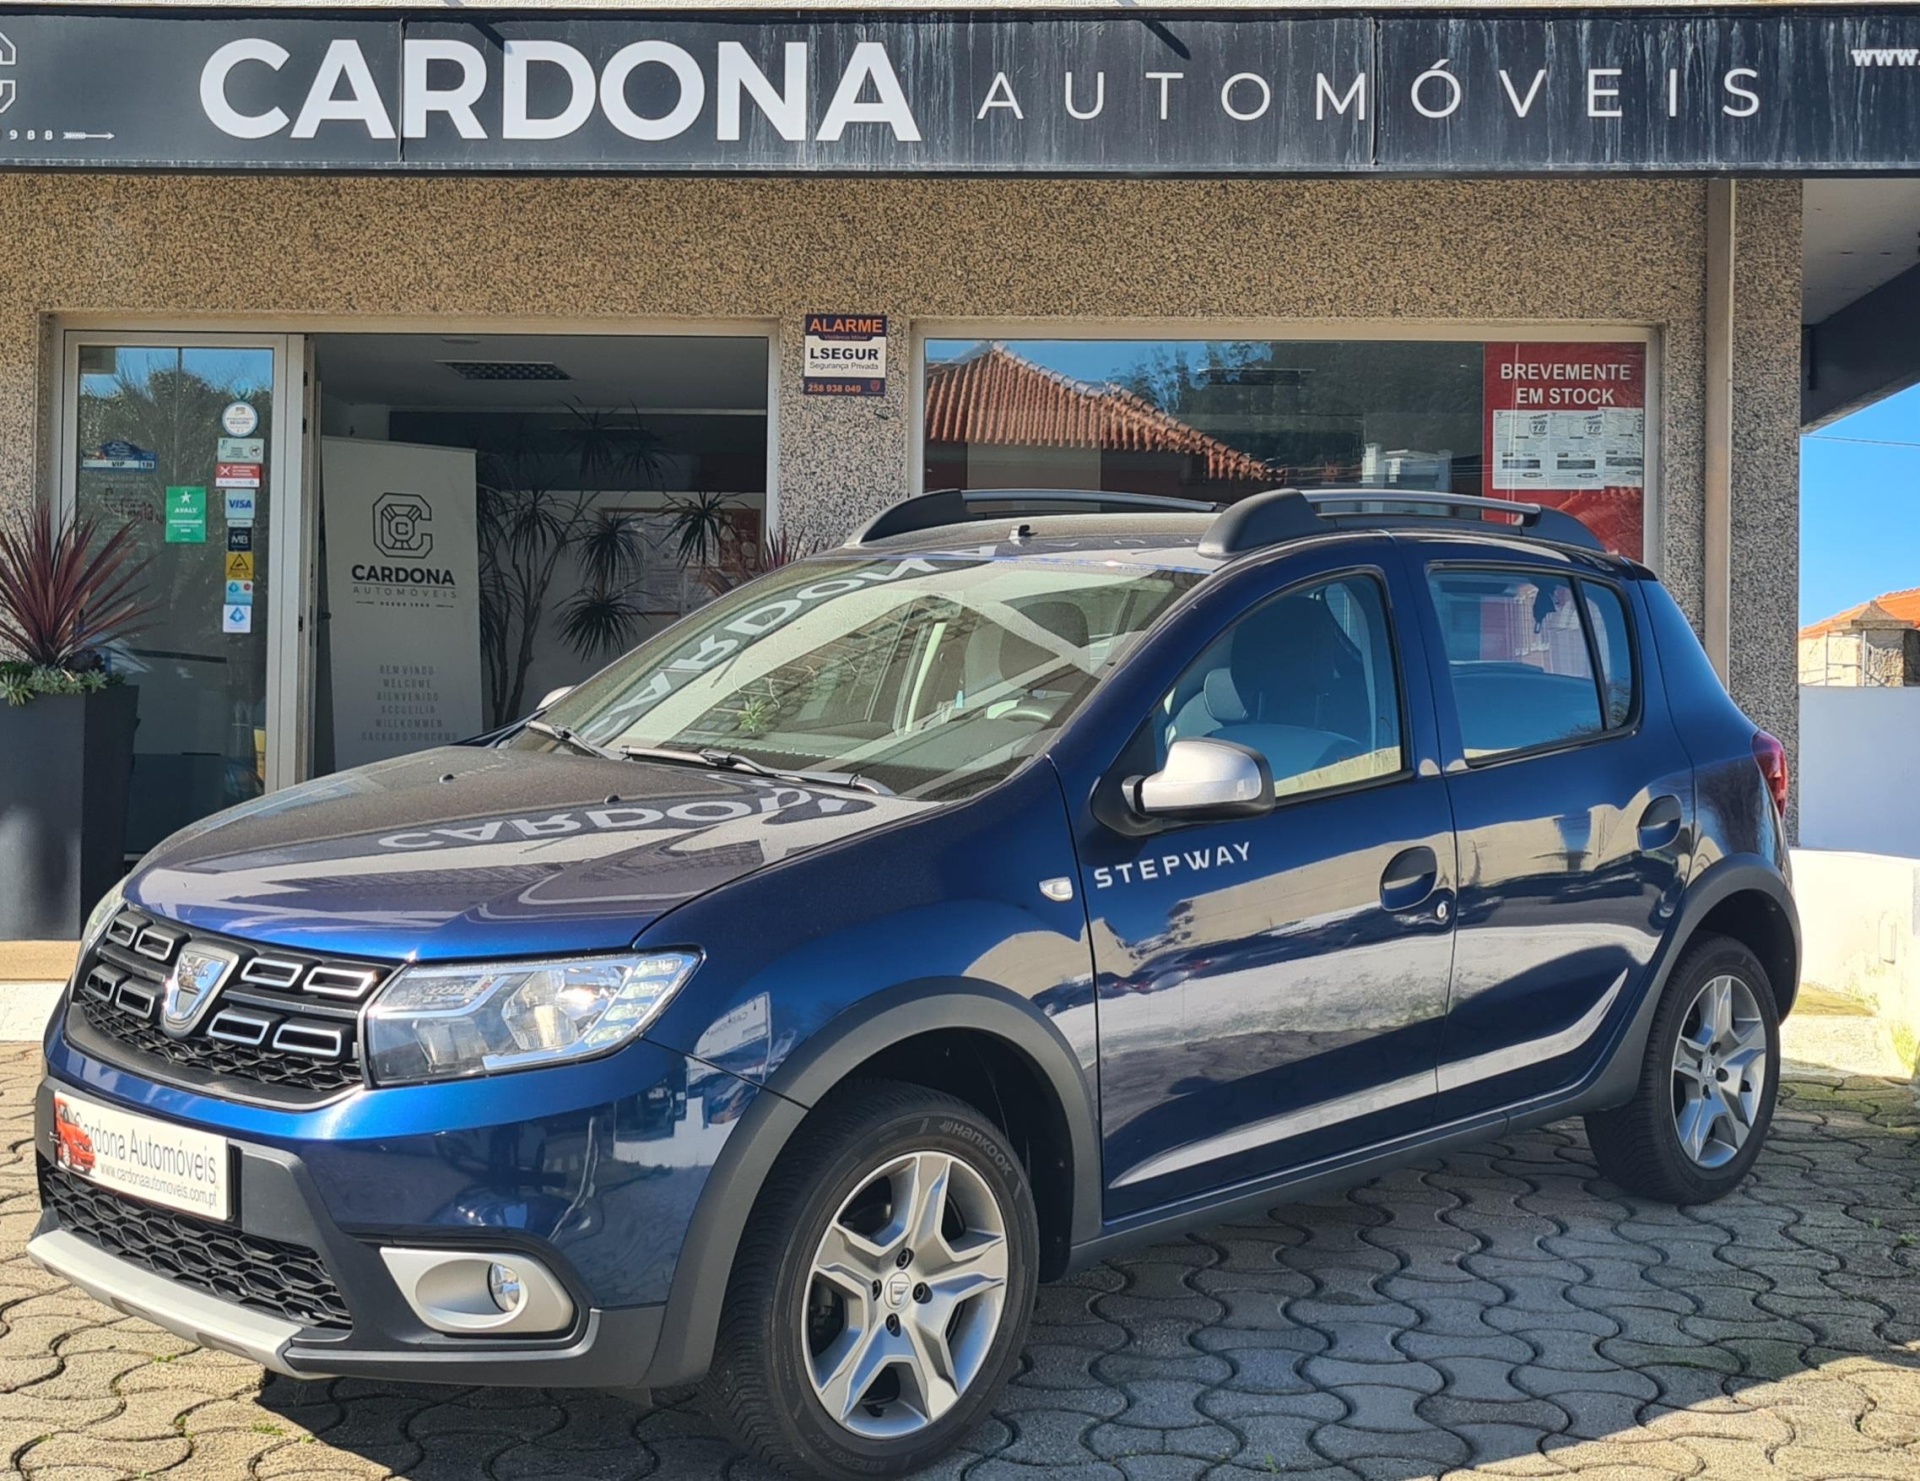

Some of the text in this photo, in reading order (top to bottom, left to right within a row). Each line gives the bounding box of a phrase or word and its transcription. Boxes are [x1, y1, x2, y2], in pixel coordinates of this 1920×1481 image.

[200, 37, 1761, 142] CARDONA AUTOMÓVEIS
[809, 318, 883, 333] ALARME
[809, 347, 879, 360] LSEGUR
[809, 361, 879, 371] Segurança Privada
[1500, 363, 1631, 380] BREVEMENTE
[807, 384, 824, 392] 258
[826, 384, 842, 392] 938
[845, 384, 862, 393] 049
[1516, 388, 1615, 405] EM STOCK
[228, 499, 252, 509] VISA
[351, 564, 456, 586] CARDONA
[1093, 841, 1251, 889] STEPWAY
[129, 1128, 217, 1185] Automóveis
[100, 1162, 218, 1210] www.cardonaautomoveis.com.pt
